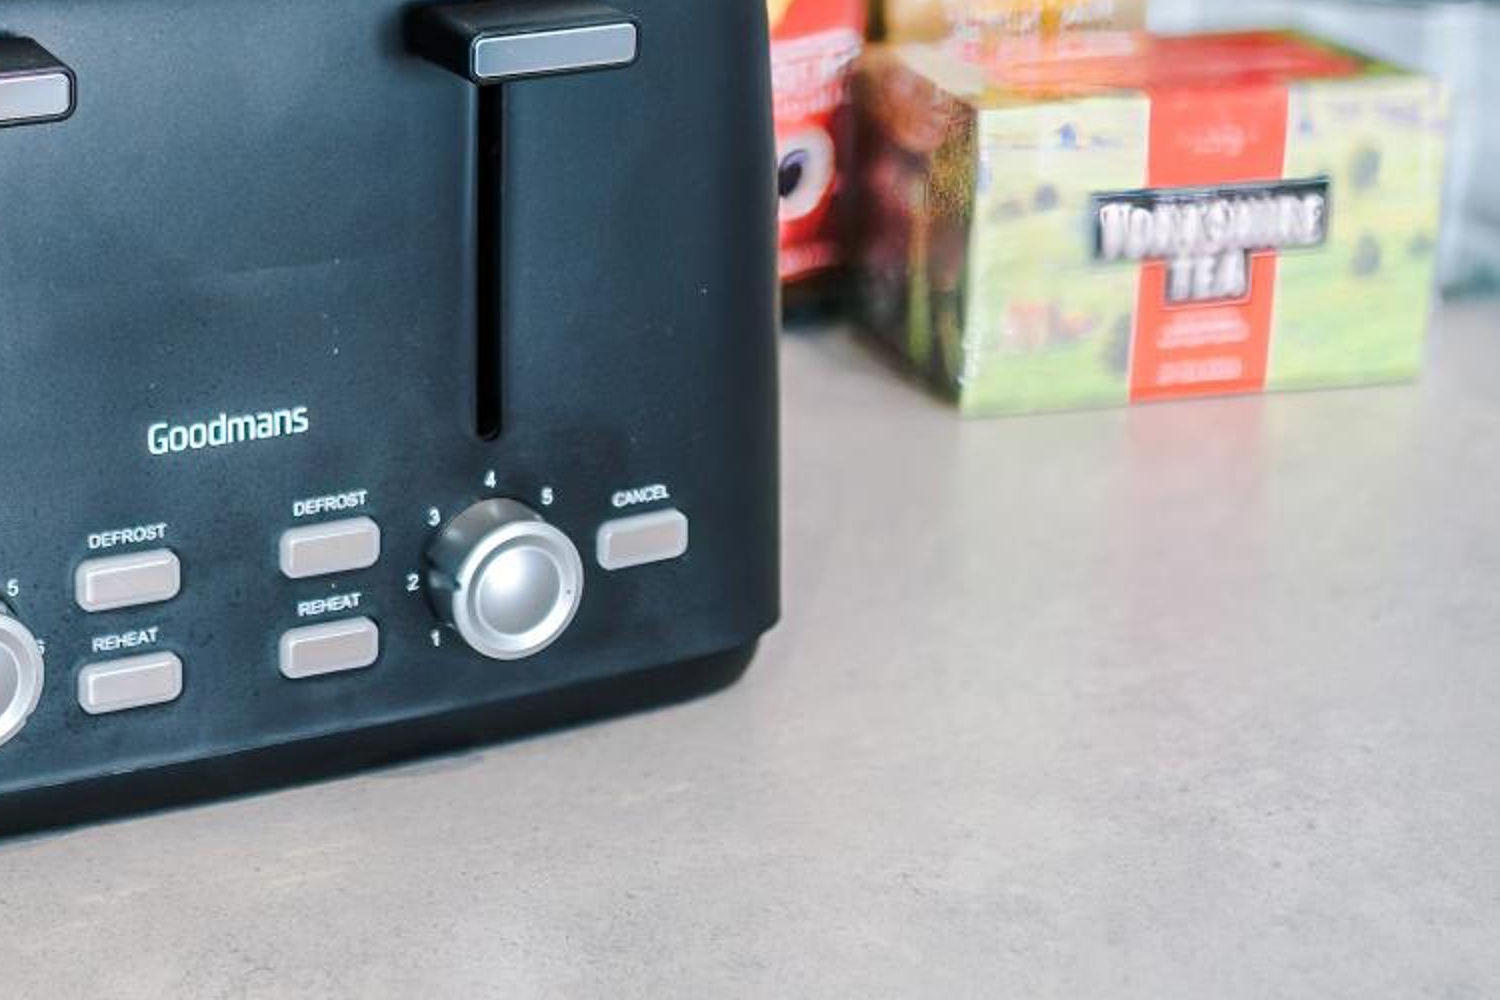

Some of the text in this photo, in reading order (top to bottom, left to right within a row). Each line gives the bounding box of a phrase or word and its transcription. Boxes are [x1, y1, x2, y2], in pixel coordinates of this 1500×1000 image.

[1168, 250, 1248, 301] TEA
[147, 406, 309, 455] Goodmans
[484, 470, 496, 488] 4
[293, 489, 369, 517] DEFROST
[541, 487, 554, 505] 5
[611, 483, 671, 507] CANCEL
[428, 508, 441, 527] 3
[87, 522, 168, 549] DEFROST
[7, 578, 20, 597] 5
[406, 573, 420, 591] 2
[298, 592, 362, 617] REHEAT
[92, 626, 160, 653] REHEAT
[430, 630, 440, 647] 1
